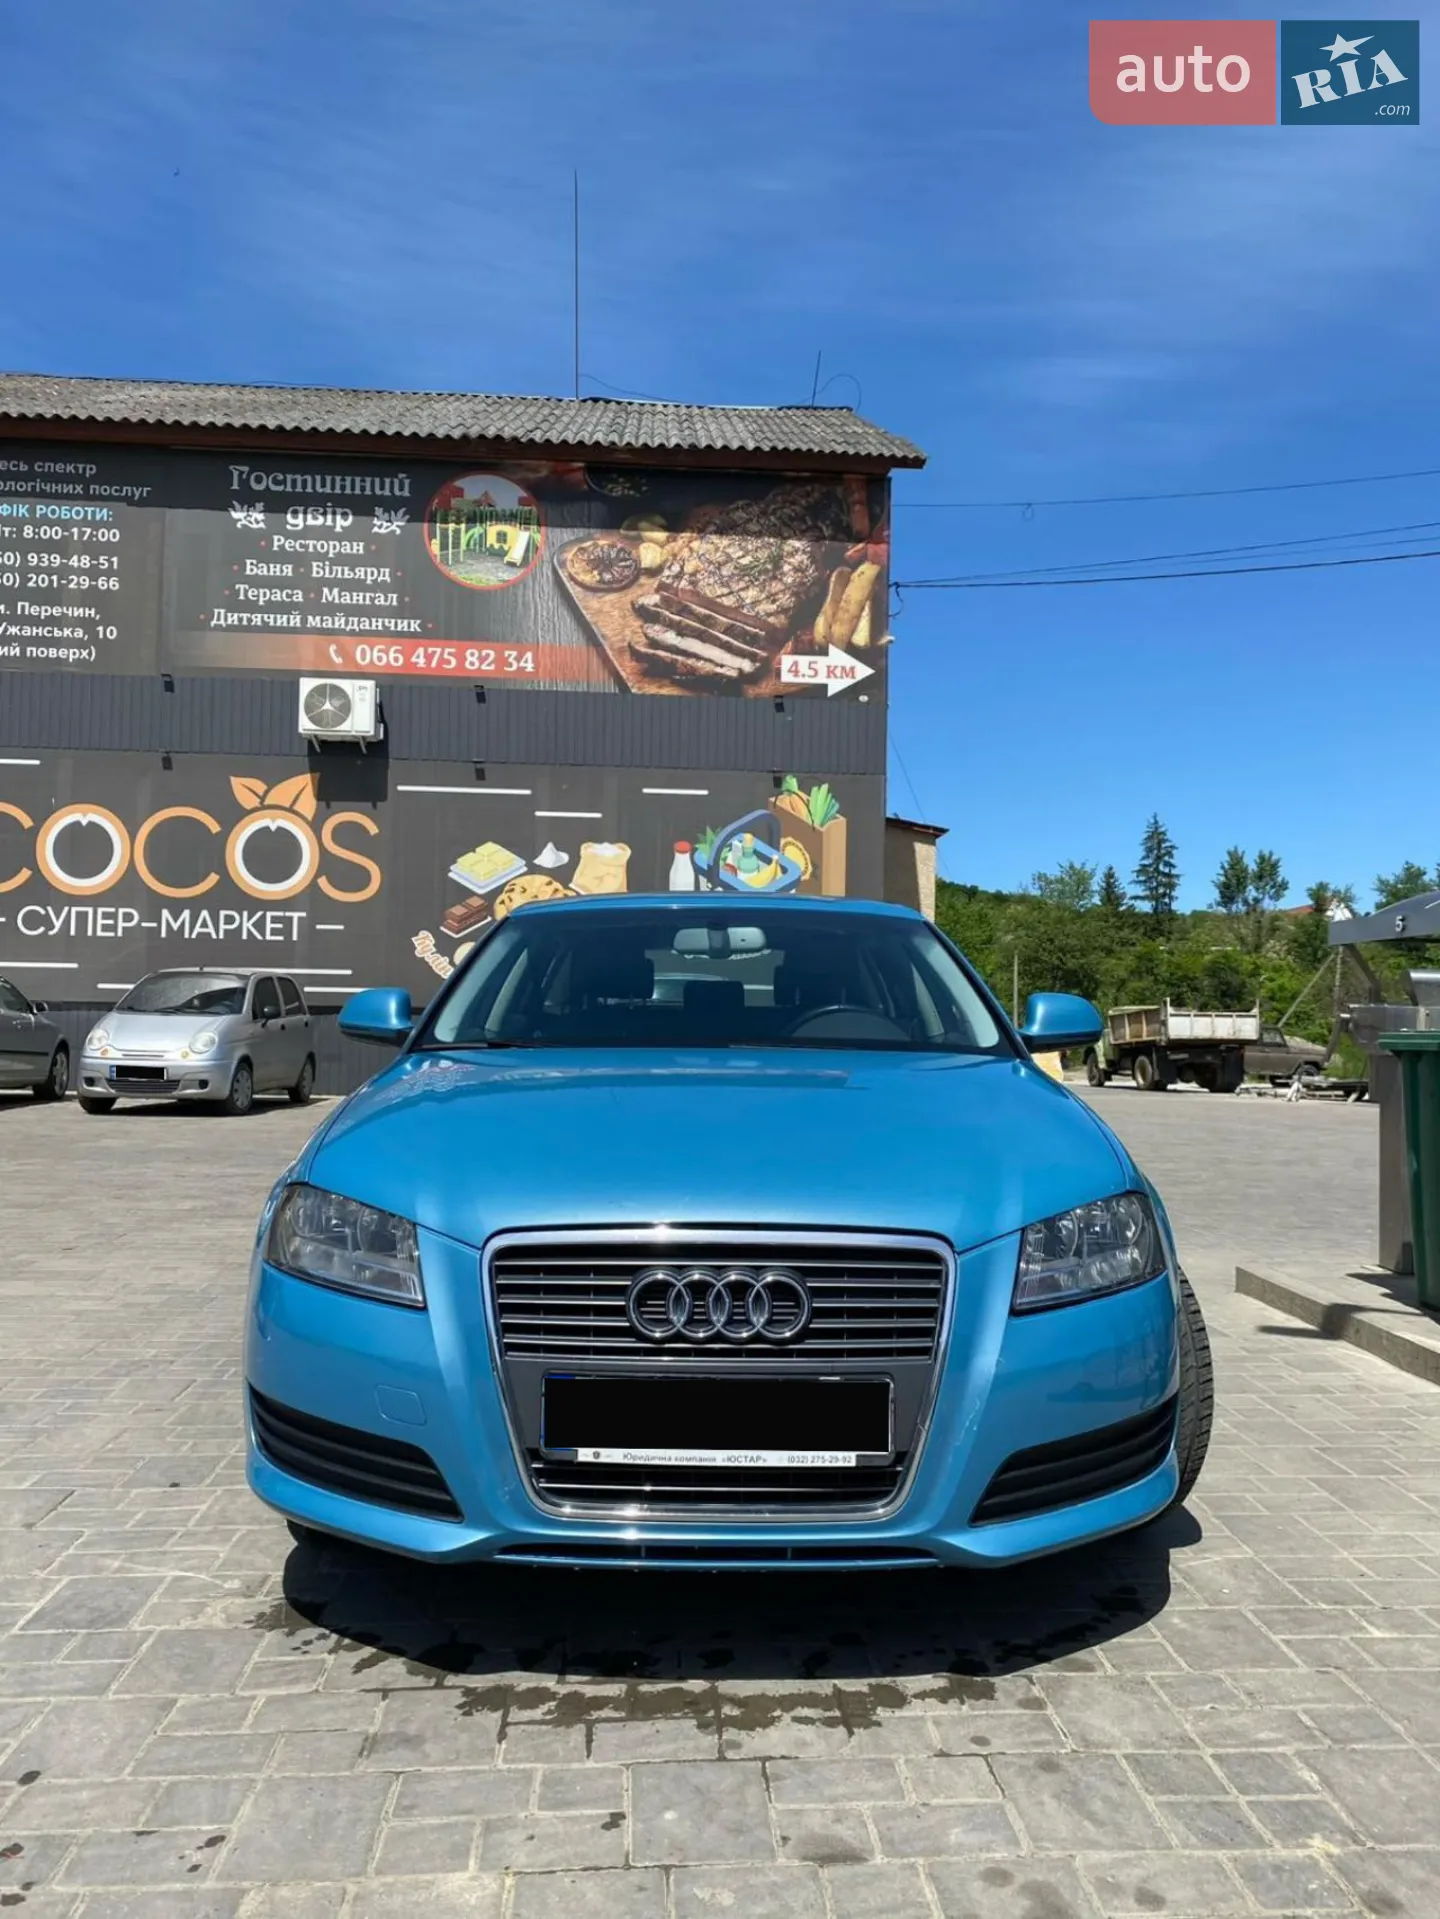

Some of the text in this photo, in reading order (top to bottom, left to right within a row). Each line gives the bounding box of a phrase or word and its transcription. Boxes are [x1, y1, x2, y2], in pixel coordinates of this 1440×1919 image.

[34, 461, 97, 477] спектр
[229, 465, 411, 497] Гостинний
[89, 484, 152, 500] послуг
[36, 505, 113, 521] РОБОТИ:
[286, 502, 353, 532] двір
[0, 524, 120, 542] т: 8:00-17:00
[272, 535, 364, 558] Ресторан
[0, 551, 118, 570] 0) 939-48-51
[245, 560, 391, 583] Баня Більярд
[0, 572, 120, 591] 0) 201-29-66
[235, 584, 398, 606] Тераса Мангал
[17, 601, 101, 620] Перечин,
[210, 607, 422, 633] Дитячий майданчик
[96, 626, 118, 639] 10
[26, 646, 96, 662] поверх)
[355, 644, 535, 672] 066 475 82 34
[787, 660, 818, 678] 4.5
[16, 905, 306, 940] СУПЕР-МАРКЕТ
[1395, 915, 1403, 932] 5
